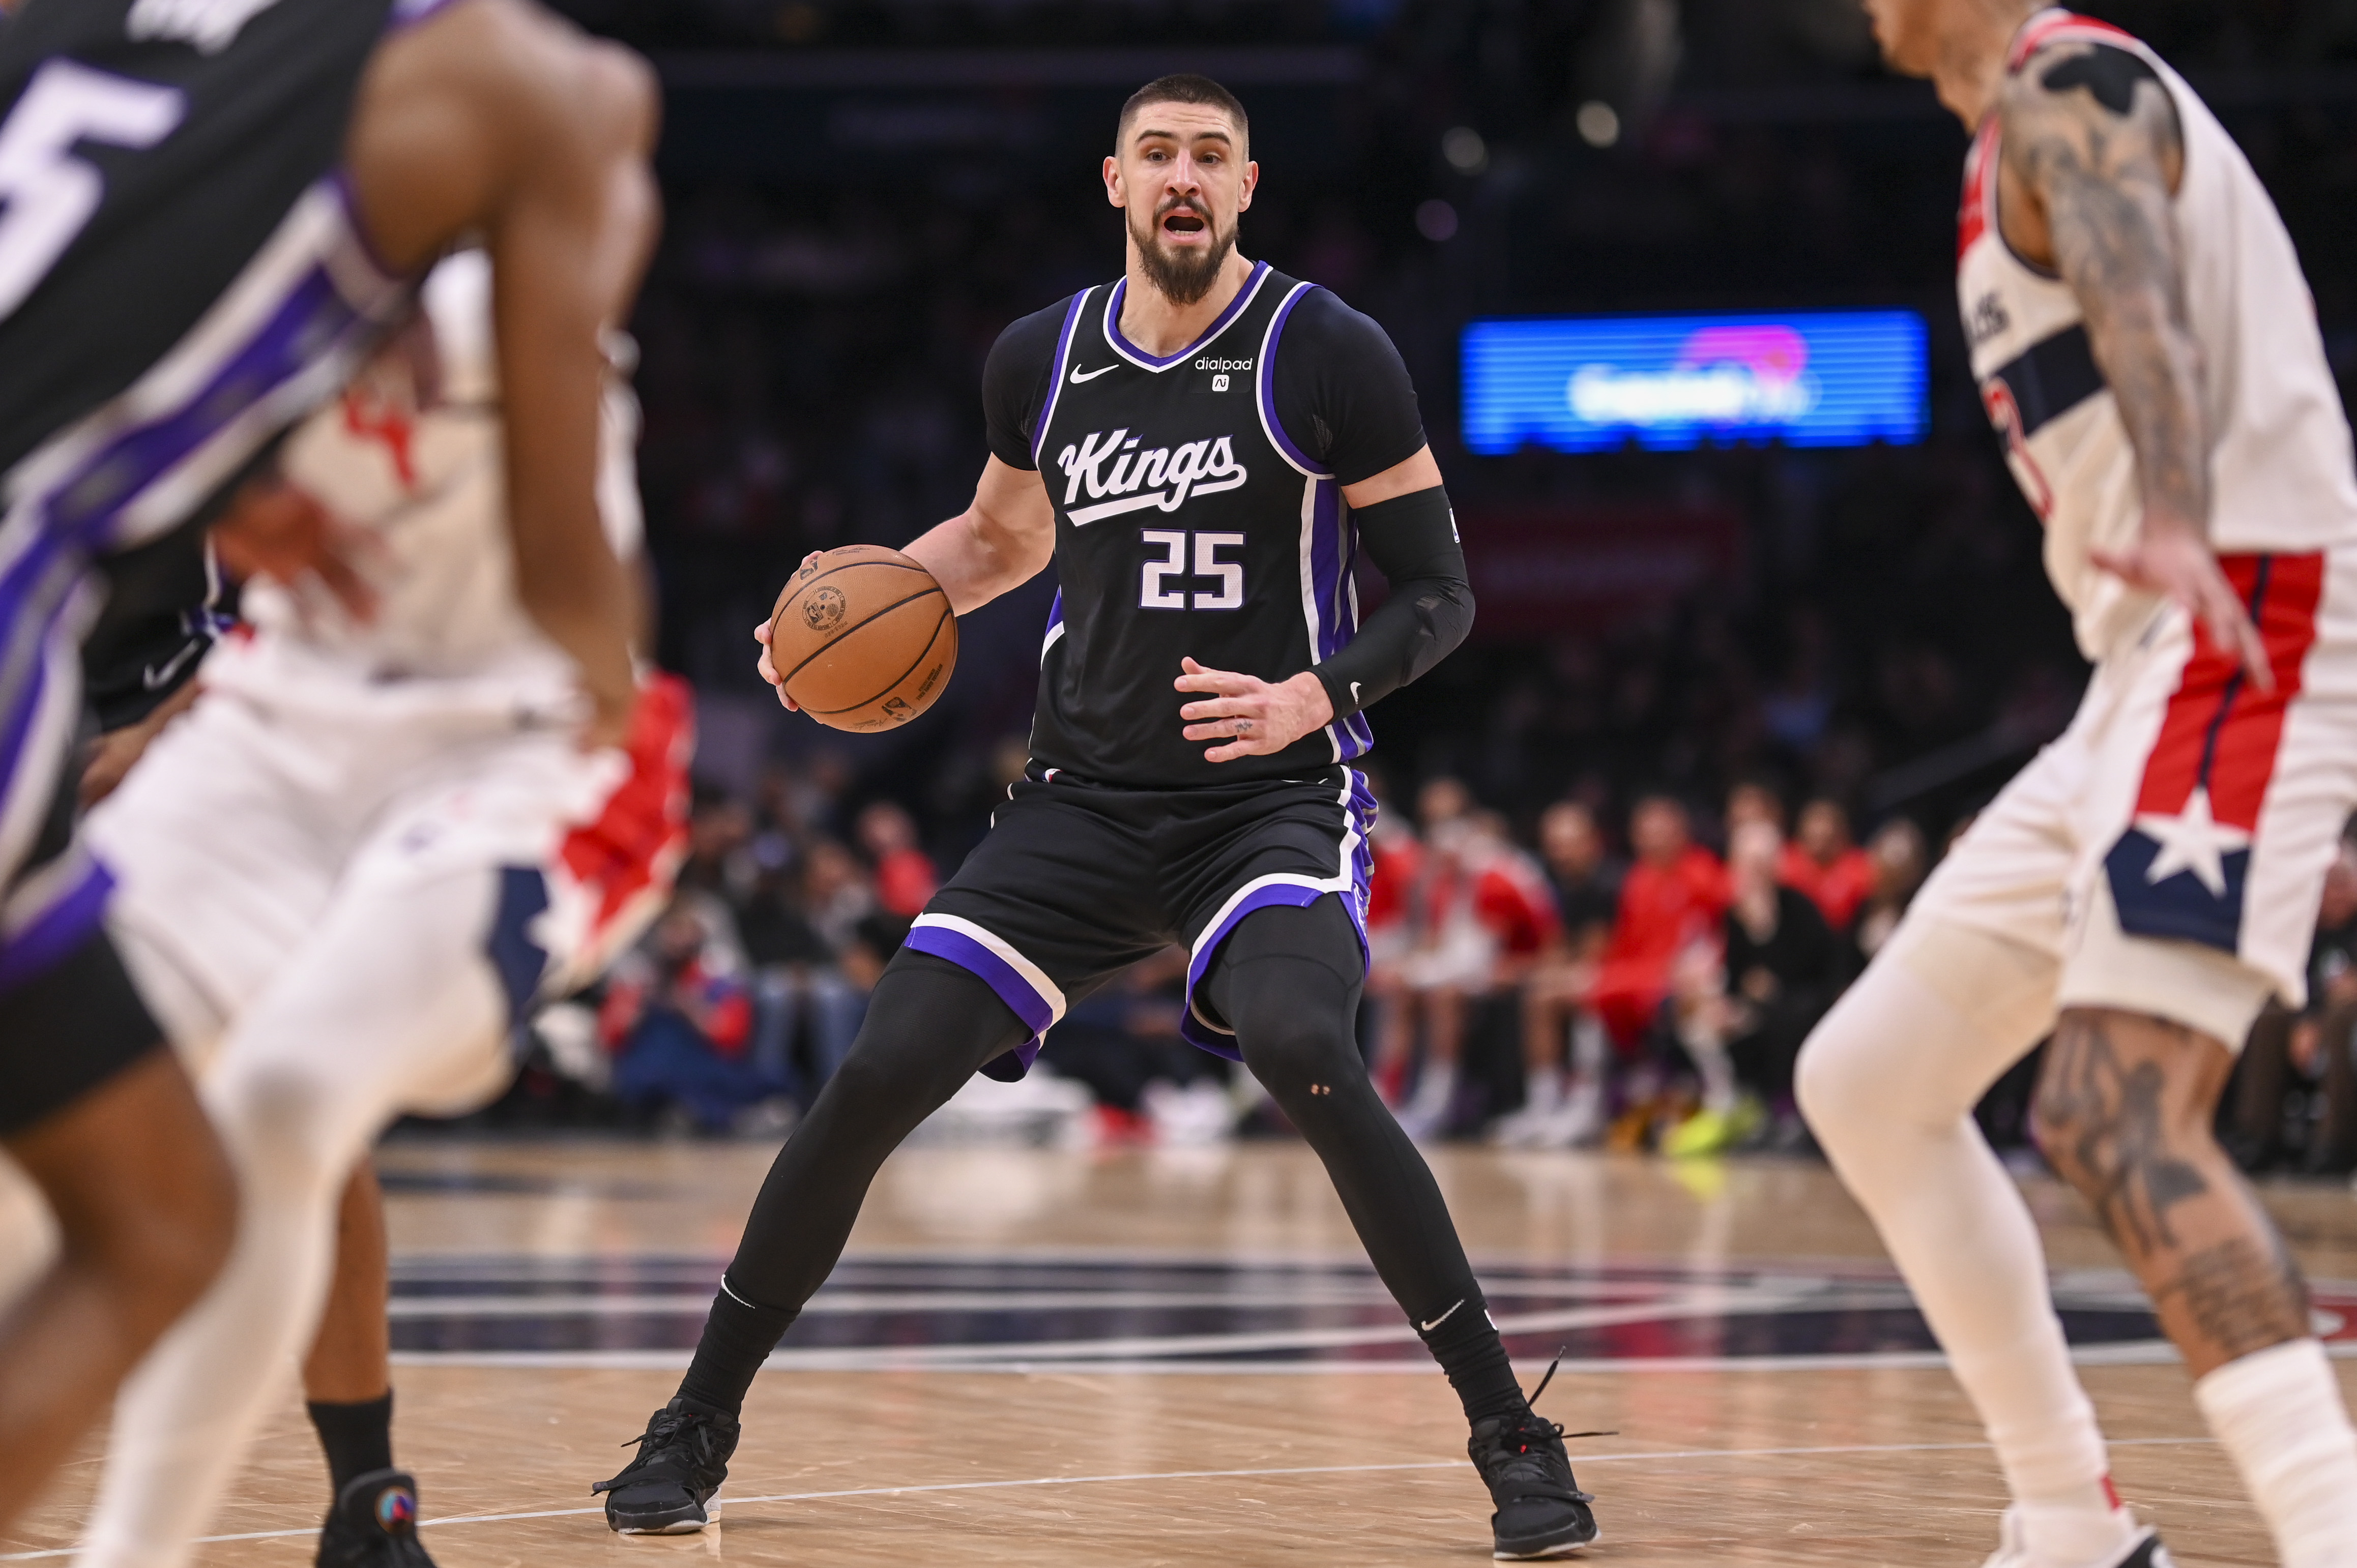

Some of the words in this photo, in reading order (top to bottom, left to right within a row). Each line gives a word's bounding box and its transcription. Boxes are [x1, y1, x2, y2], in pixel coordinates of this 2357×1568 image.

[1195, 357, 1253, 373] dialpad
[1057, 427, 1247, 527] Kings
[1138, 528, 1246, 610] 25
